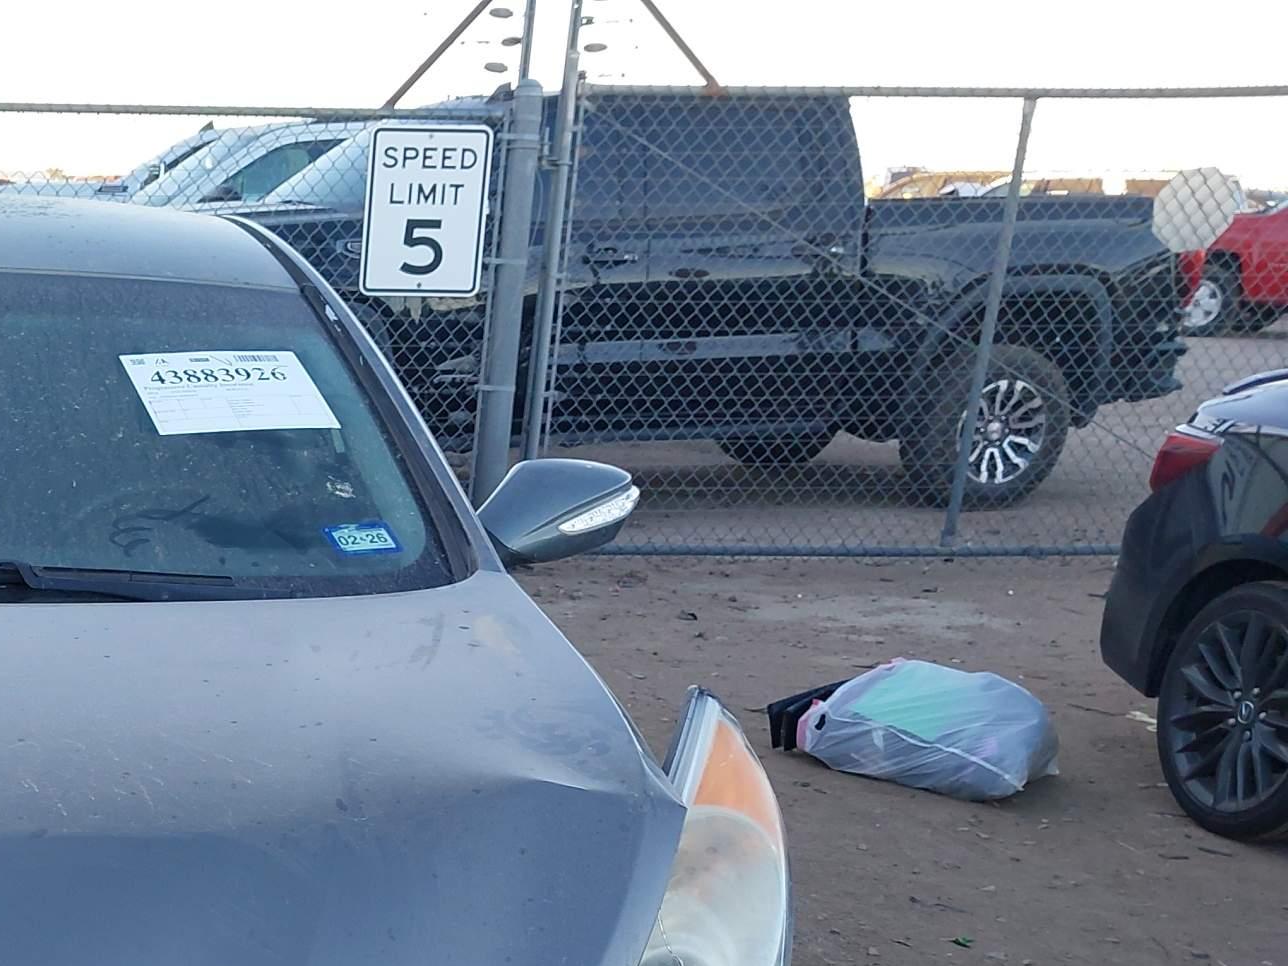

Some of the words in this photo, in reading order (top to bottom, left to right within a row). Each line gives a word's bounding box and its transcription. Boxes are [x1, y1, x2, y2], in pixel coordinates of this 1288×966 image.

[382, 146, 478, 170] SPEED
[389, 183, 464, 205] LIMIT
[399, 219, 443, 276] 5
[150, 367, 288, 385] 43883926
